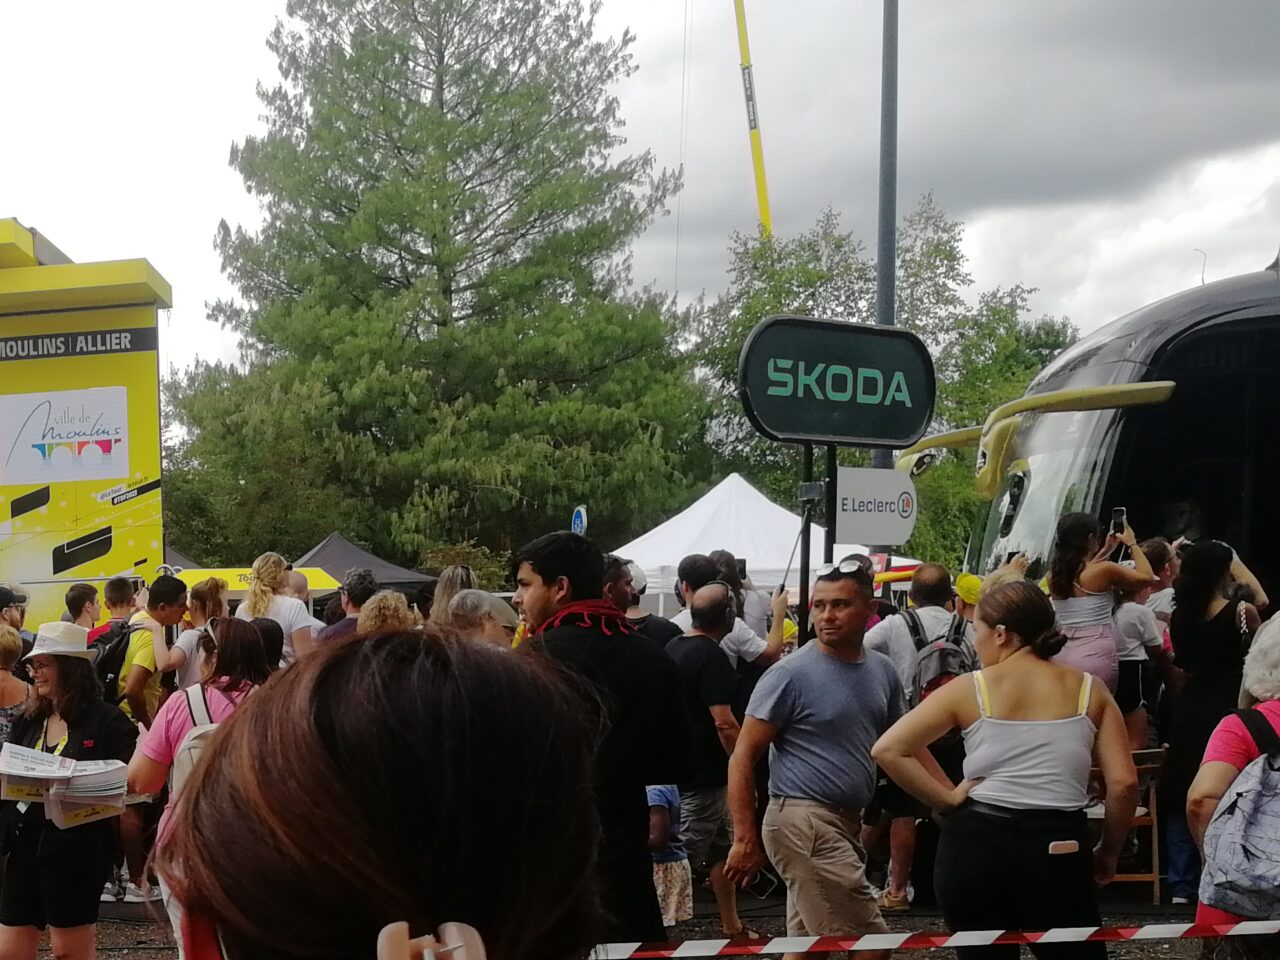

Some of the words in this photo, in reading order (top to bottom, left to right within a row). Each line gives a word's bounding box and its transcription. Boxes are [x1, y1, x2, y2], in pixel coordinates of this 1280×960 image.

[76, 332, 131, 353] ALLIER
[54, 406, 76, 425] ville
[79, 404, 91, 423] de
[841, 497, 896, 513] E.Leclerc
